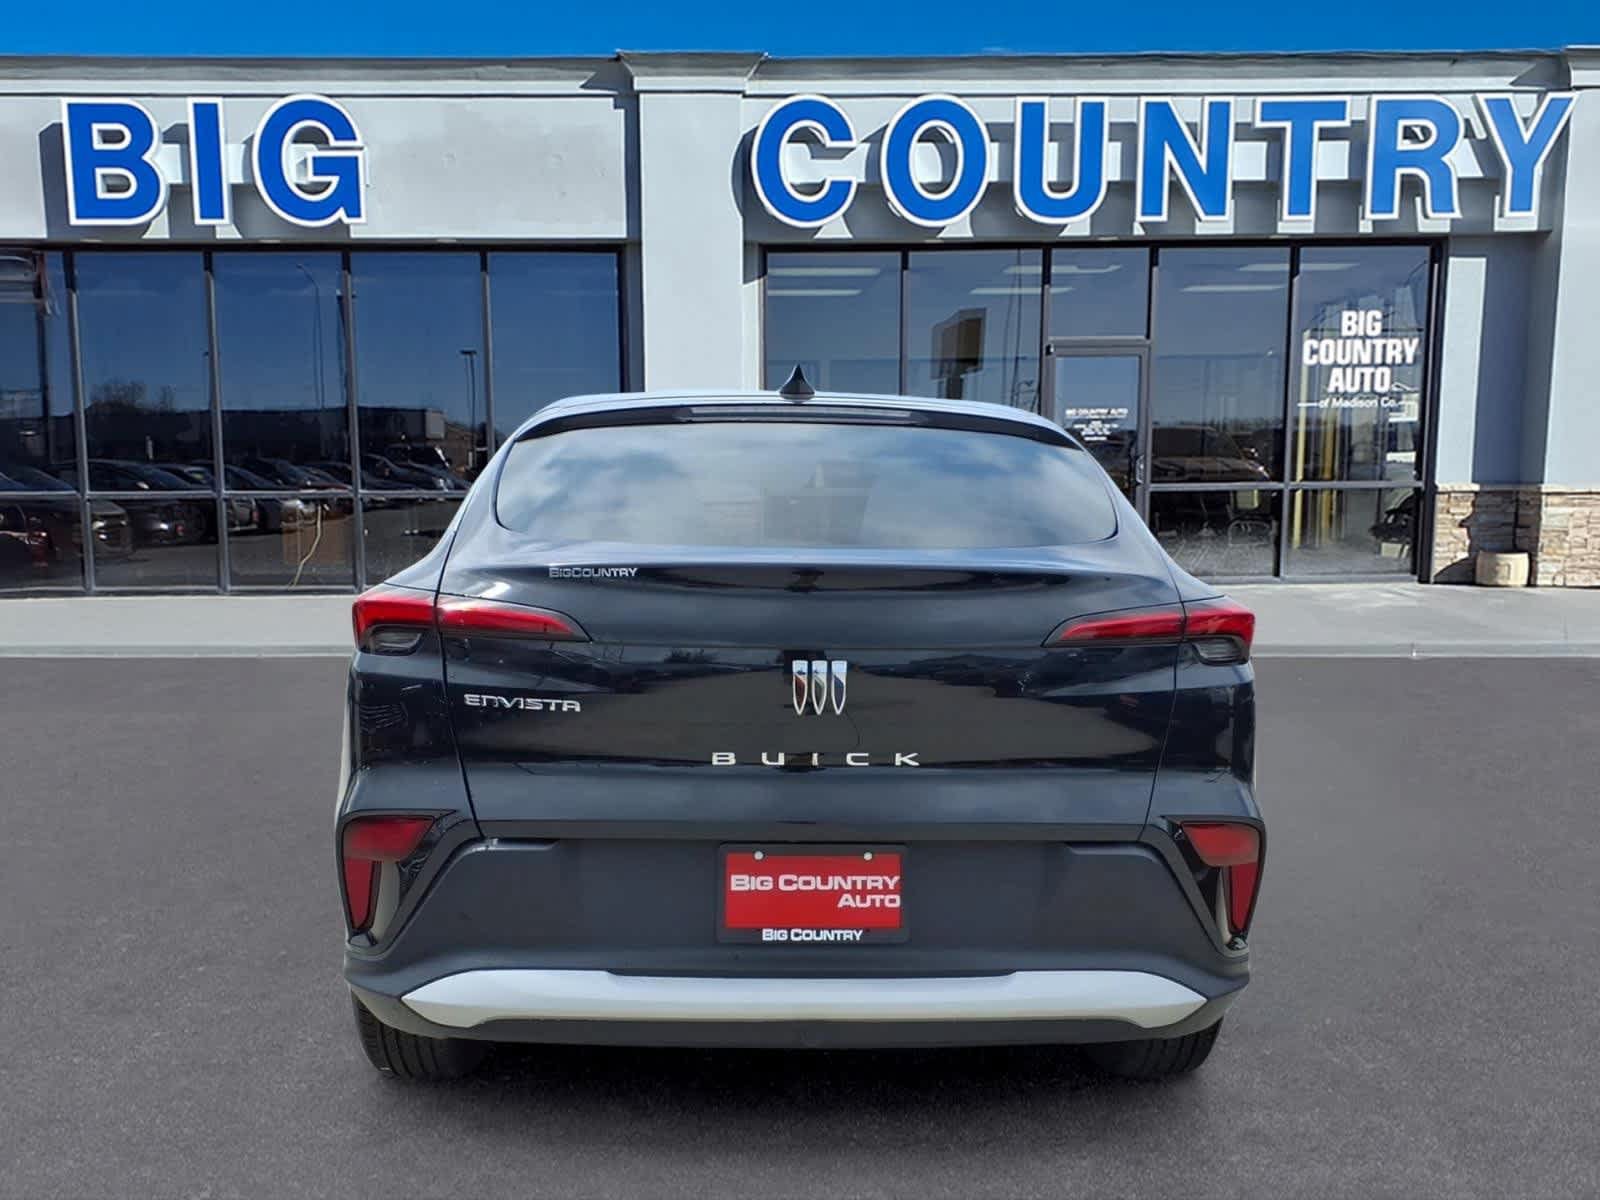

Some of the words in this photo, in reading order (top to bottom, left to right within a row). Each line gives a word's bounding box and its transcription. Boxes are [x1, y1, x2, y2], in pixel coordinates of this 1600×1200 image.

[61, 94, 367, 227] BIG
[751, 94, 1575, 228] COUNTRY
[1341, 309, 1383, 337] BIG
[1303, 338, 1420, 366] COUNTRY
[1327, 366, 1392, 394] AUTO
[1331, 397, 1378, 409] Madison
[463, 693, 581, 712] ENVISTA
[711, 752, 920, 766] BUICK
[730, 874, 773, 891] BIG
[778, 874, 900, 891] COUNTRY
[837, 894, 901, 908] AUTO
[761, 928, 788, 941] BIG
[790, 928, 863, 941] COUNTRY
